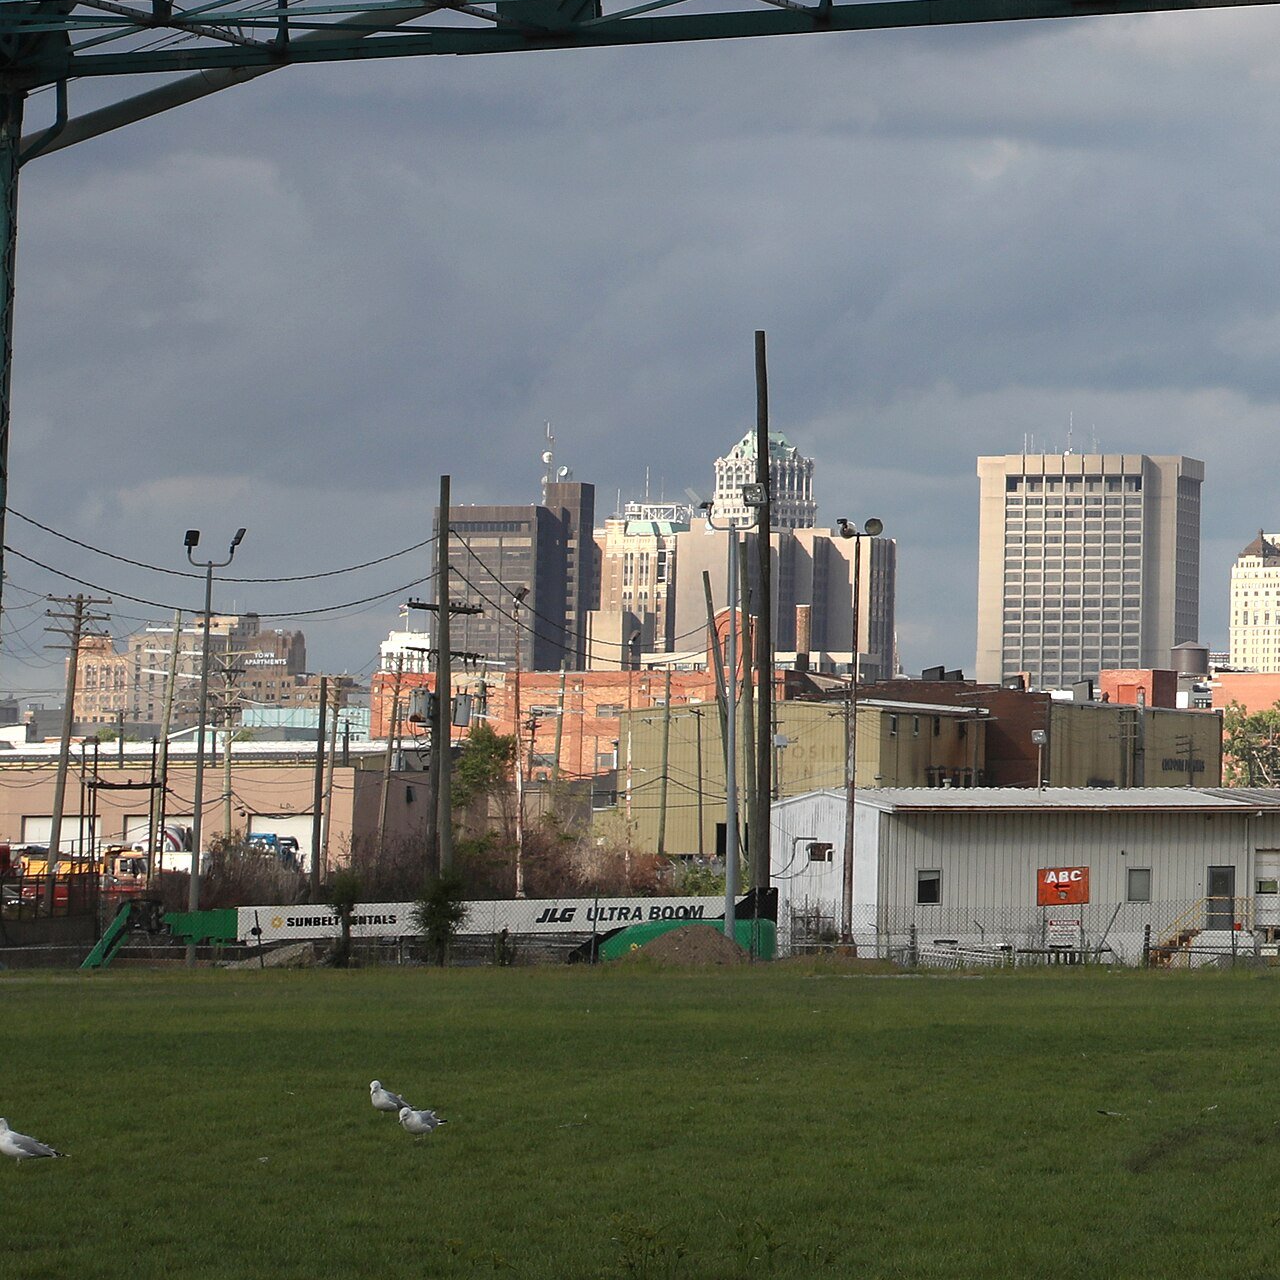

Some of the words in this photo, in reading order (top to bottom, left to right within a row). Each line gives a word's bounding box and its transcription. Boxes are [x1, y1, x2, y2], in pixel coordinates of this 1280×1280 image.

[244, 658, 287, 666] APARTMENTS
[1044, 870, 1082, 883] ABC
[536, 907, 576, 923] JLG
[586, 906, 643, 921] ULTRA
[650, 904, 705, 921] BOOM
[286, 916, 340, 927] SUNBELT
[350, 914, 397, 926] ENTALS
